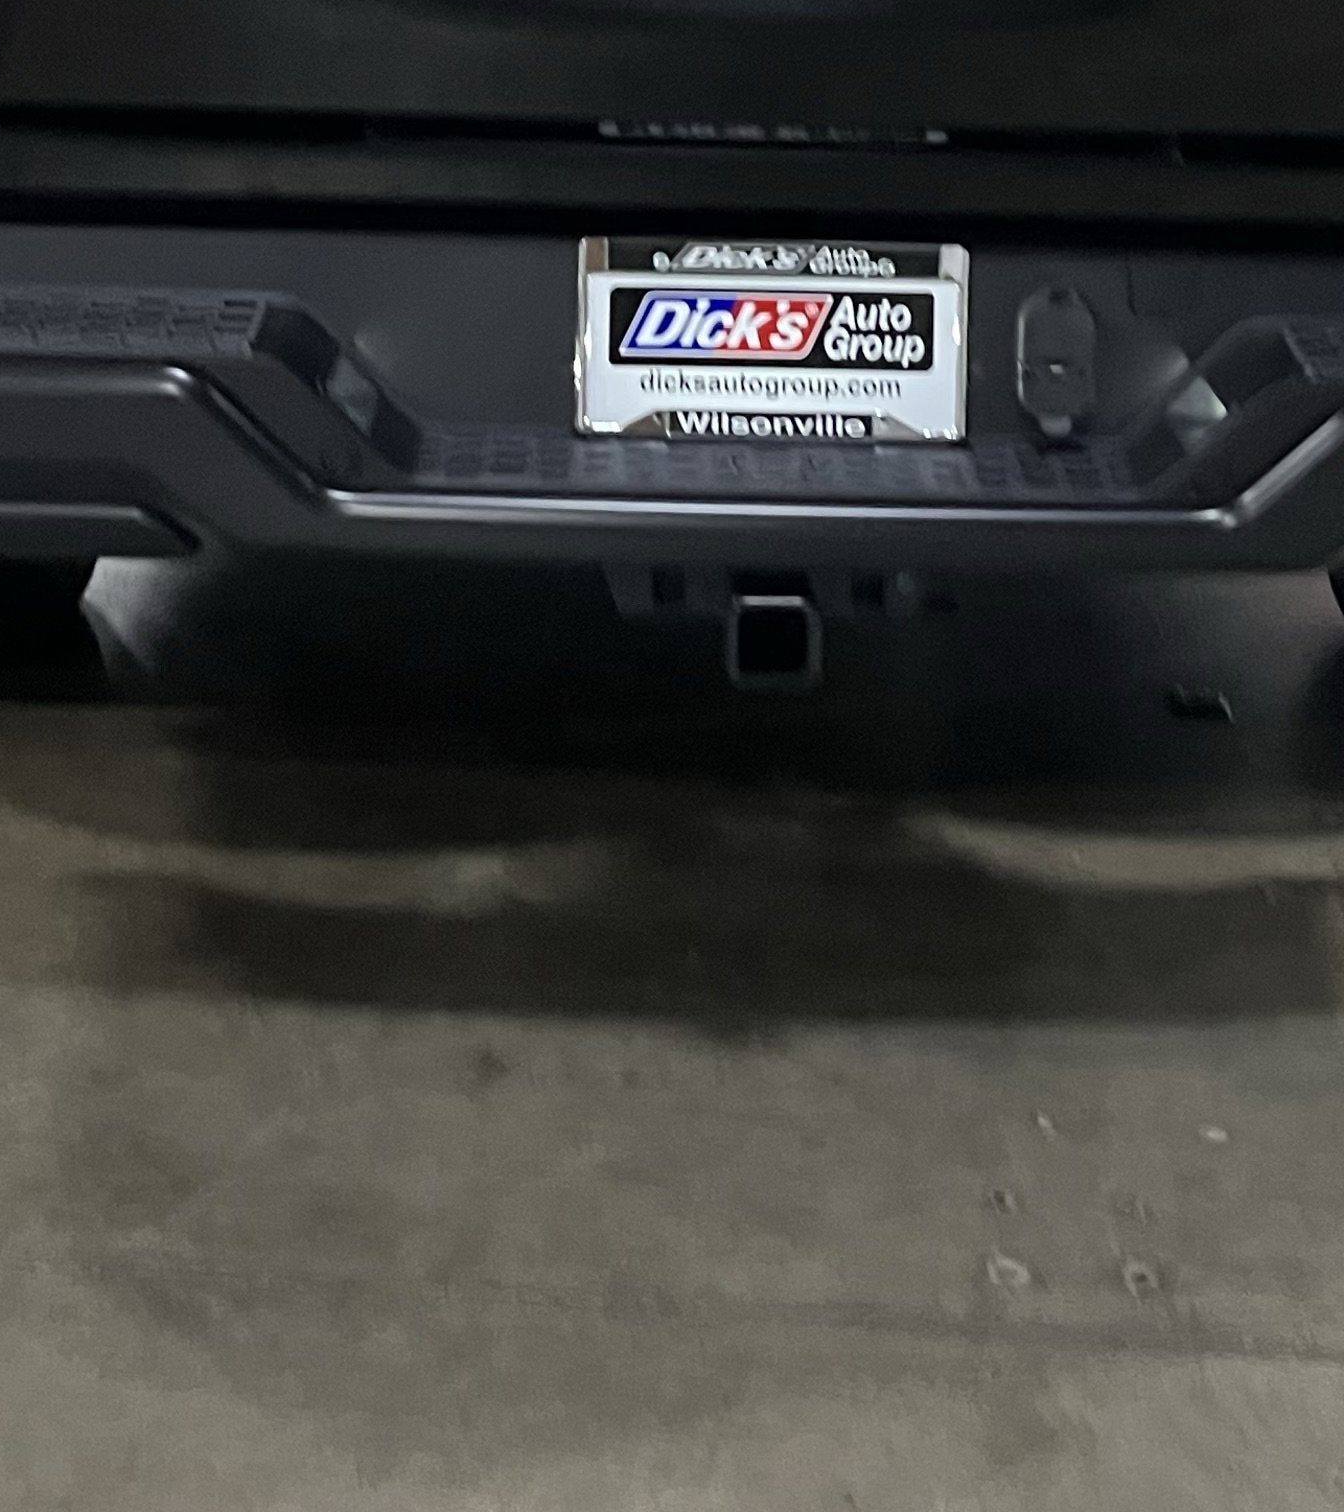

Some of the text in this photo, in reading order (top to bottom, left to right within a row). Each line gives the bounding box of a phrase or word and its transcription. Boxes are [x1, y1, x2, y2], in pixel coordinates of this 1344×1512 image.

[635, 297, 808, 350] Dick's
[830, 295, 913, 332] Auto
[823, 329, 926, 369] Group
[640, 368, 902, 399] dicksautogroup.com
[676, 411, 867, 438] Wilsonville
